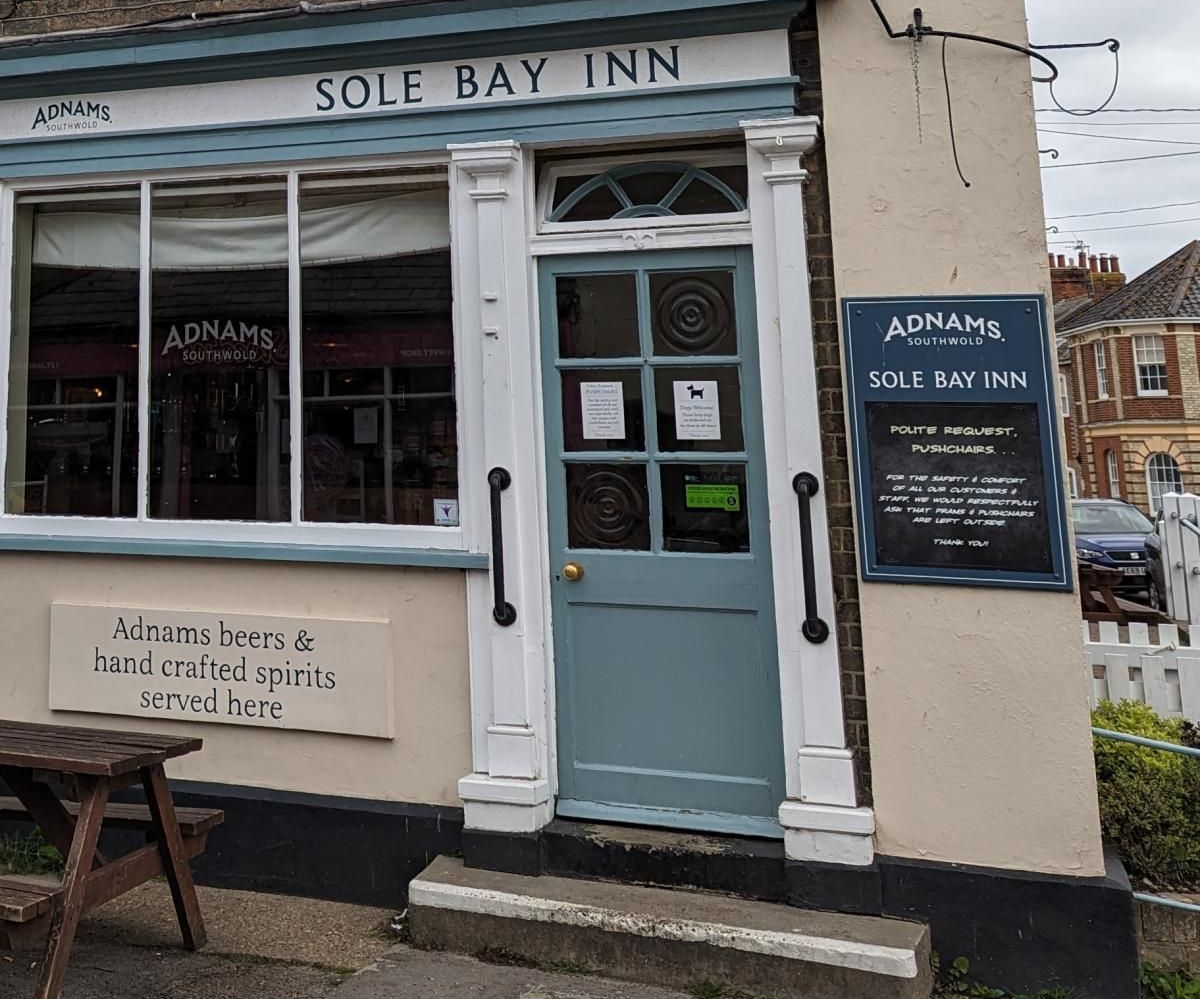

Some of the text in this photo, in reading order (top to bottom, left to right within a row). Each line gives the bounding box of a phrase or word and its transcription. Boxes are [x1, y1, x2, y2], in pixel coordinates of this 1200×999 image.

[315, 45, 680, 112] SOLE BAY INN
[46, 121, 97, 132] SOUTHWOLD
[907, 337, 984, 346] SOUTHWOLD
[182, 350, 257, 361] SOUTHWOLD
[869, 371, 1027, 389] SOLE BAY INN
[890, 425, 937, 434] POLITE
[966, 498, 1039, 507] RESPECTFULLY
[978, 509, 1035, 517] PUSHCHAIRS
[112, 616, 315, 652] Adnams beers &
[93, 647, 336, 692] hand crafted spirits
[140, 688, 284, 719] served here
